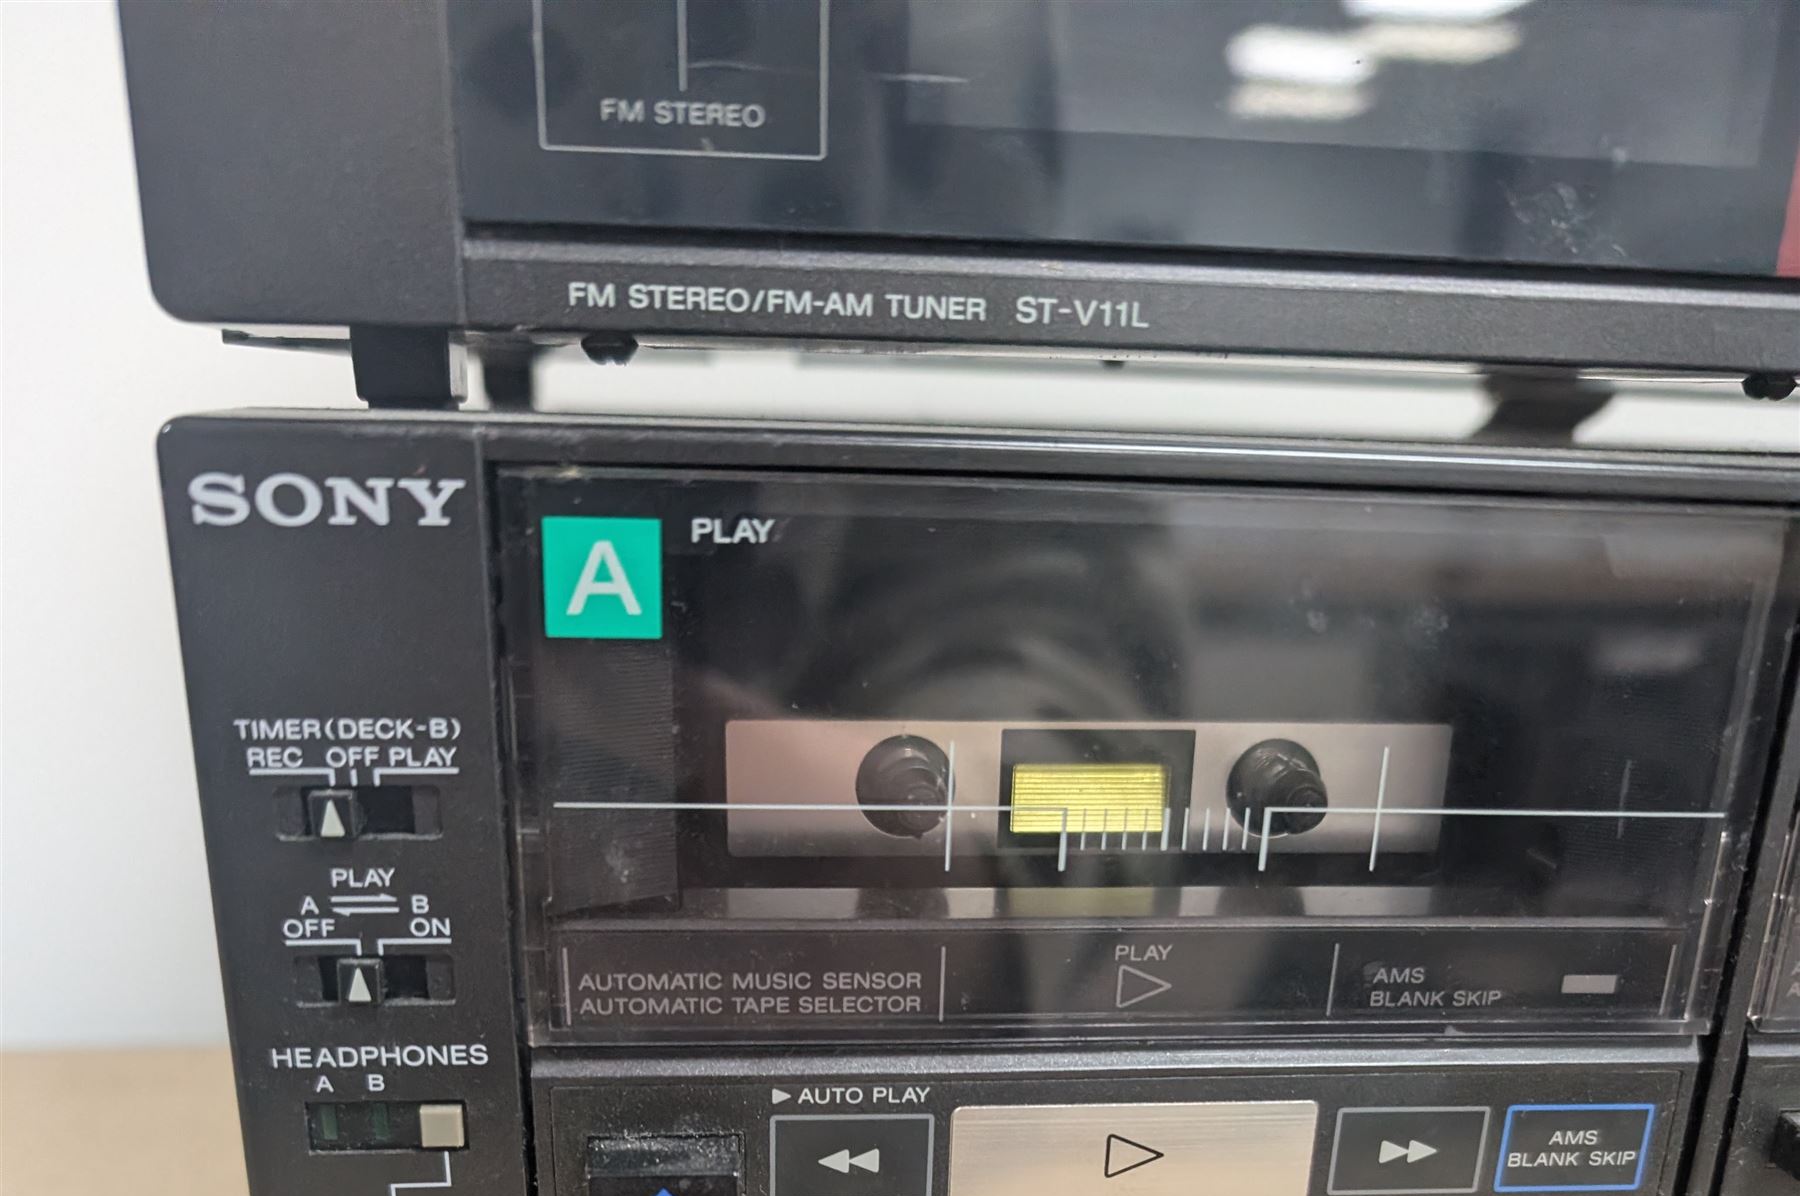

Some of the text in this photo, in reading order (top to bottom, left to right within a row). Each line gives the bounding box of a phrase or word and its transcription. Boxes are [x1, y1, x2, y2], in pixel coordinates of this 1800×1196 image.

[601, 98, 766, 128] FM STEREO
[568, 281, 1149, 329] FM STEREO/FM-AM TUNER ST-V11L
[188, 472, 466, 527] SONY
[691, 518, 775, 544] PLAY
[566, 540, 642, 616] A
[246, 746, 457, 768] REC OFF PLAY
[330, 868, 395, 888] PLAY
[300, 895, 429, 915] A B
[283, 917, 450, 938] OFF ON
[1114, 944, 1172, 961] PLAY
[578, 971, 922, 992] AUTOMATIC MUSIC SENSOR
[1373, 967, 1425, 984] AMS
[579, 996, 921, 1015] AUTOMATIC TAPE SELECTOR
[1369, 990, 1502, 1007] BLANK SKIP
[271, 1044, 489, 1069] HEADPHONES
[316, 1074, 385, 1093] A B
[798, 1086, 930, 1104] AUTO PLAY
[1548, 1130, 1598, 1146] AMS
[1507, 1151, 1636, 1168] BLANK SKIP
